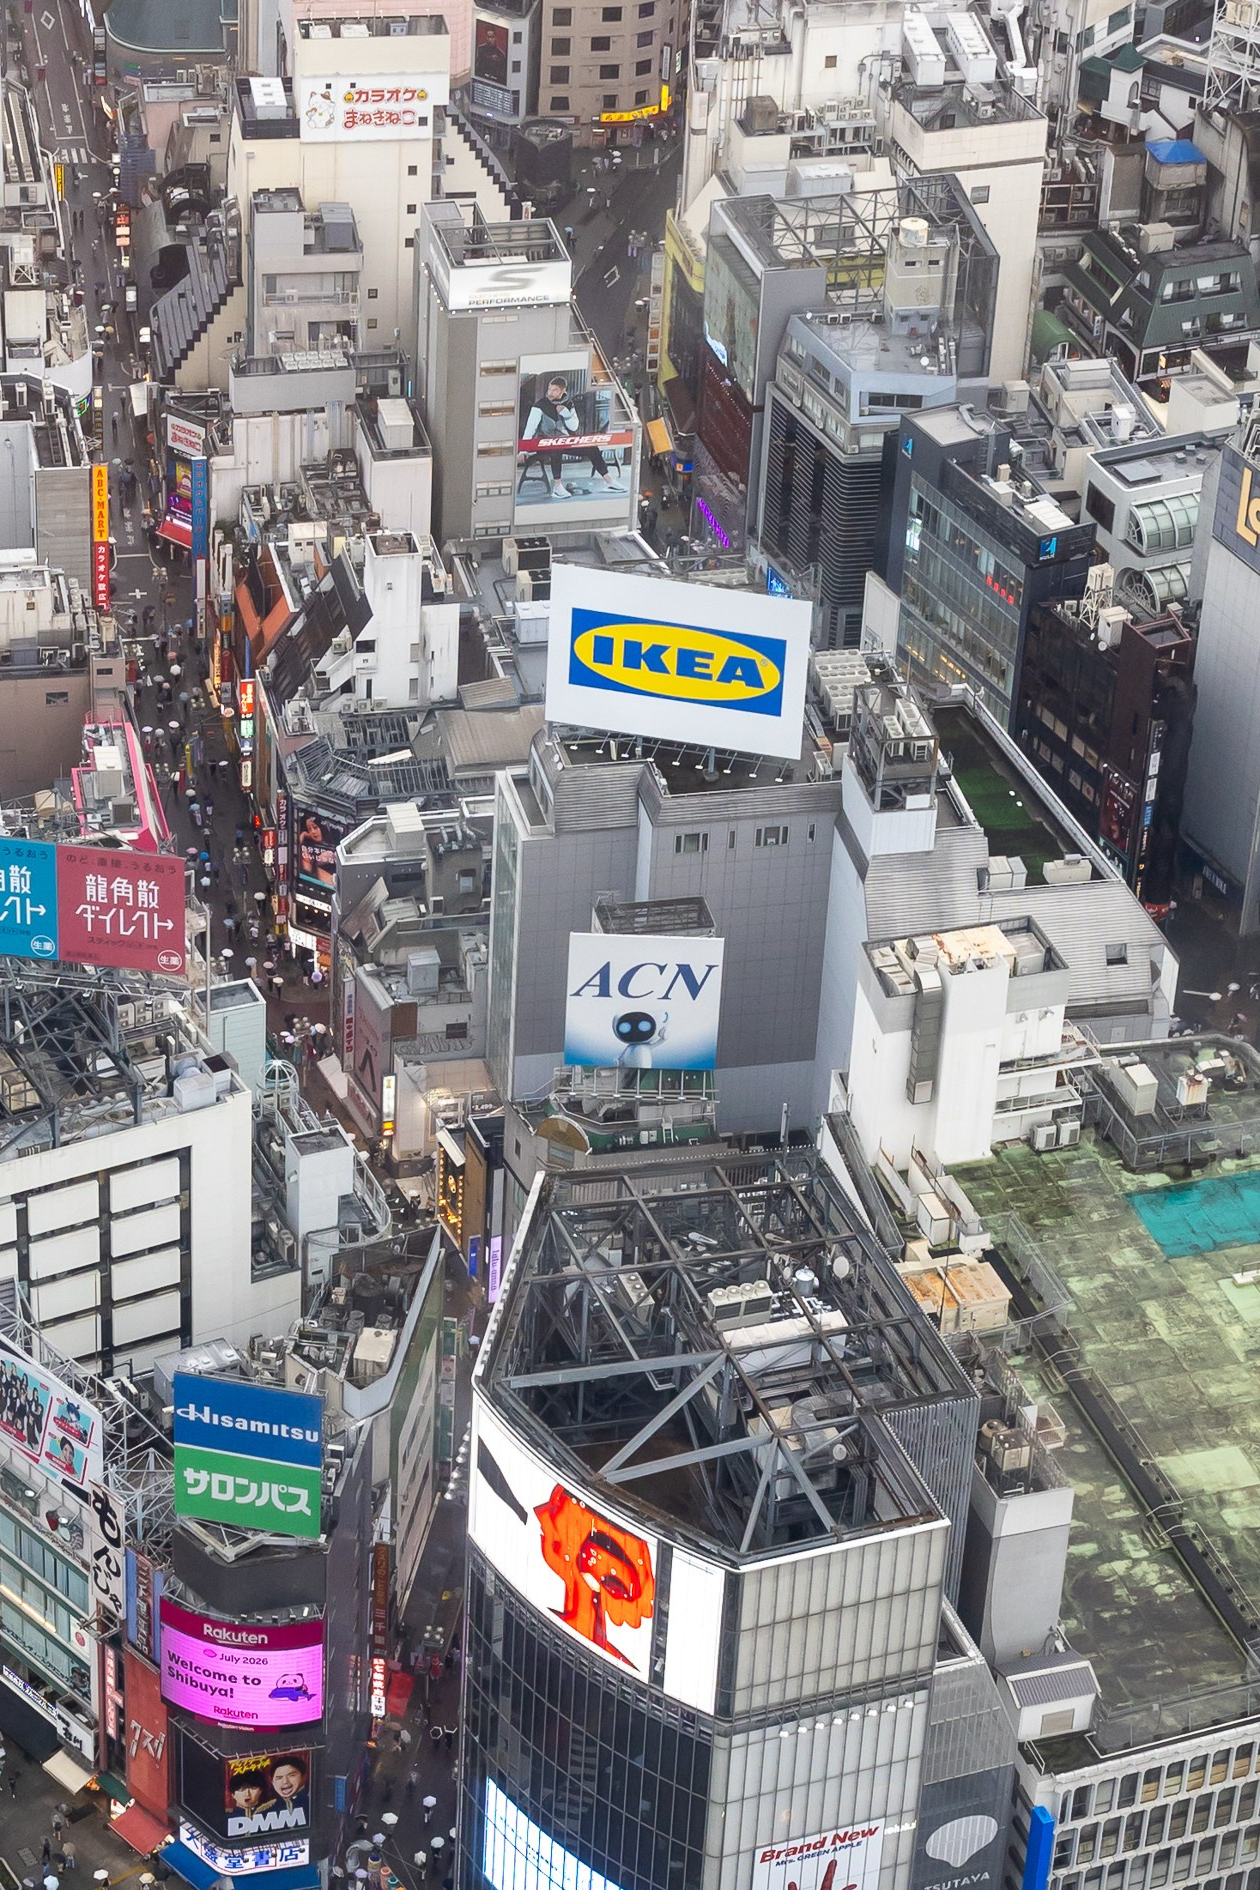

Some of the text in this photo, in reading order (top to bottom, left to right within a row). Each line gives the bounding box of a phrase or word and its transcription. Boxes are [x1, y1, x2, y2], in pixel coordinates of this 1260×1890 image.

[354, 88, 417, 103] カラオケ
[342, 108, 417, 130] まねきねこ
[468, 294, 551, 306] PERFORMANCE
[537, 433, 612, 448] SKECHERS
[593, 635, 766, 690] IKEA
[85, 874, 160, 909] 龍角散
[75, 903, 174, 940] ダイレクト
[570, 960, 719, 1001] ACN
[176, 1403, 319, 1443] Hisamitsu
[183, 1467, 312, 1516] サロンパス
[203, 1623, 269, 1645] Rakuten
[167, 1649, 262, 1686] Welcome to
[219, 1653, 240, 1665] July
[167, 1665, 234, 1699] Shibuya!
[213, 1705, 259, 1720] Rakuten
[227, 1806, 307, 1837] DMM
[759, 1835, 827, 1865] Brand
[830, 1823, 881, 1848] New
[796, 1848, 831, 1863] GREEN
[830, 1840, 863, 1855] APPLE
